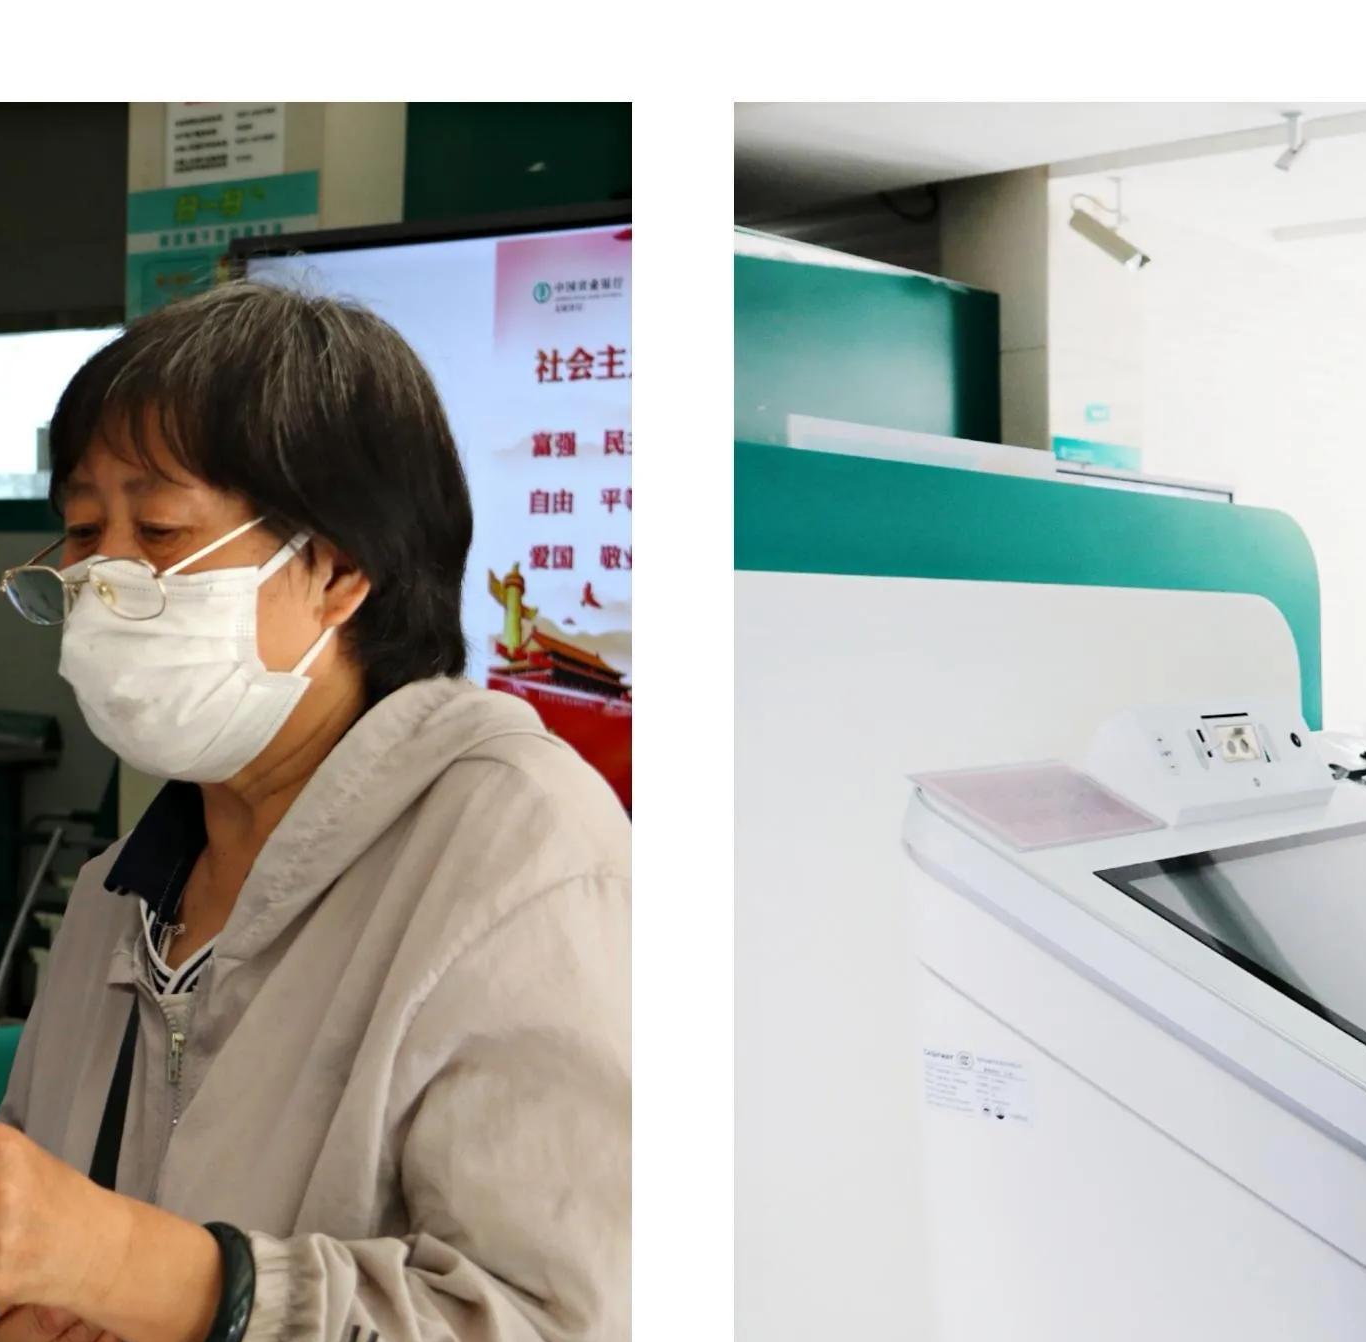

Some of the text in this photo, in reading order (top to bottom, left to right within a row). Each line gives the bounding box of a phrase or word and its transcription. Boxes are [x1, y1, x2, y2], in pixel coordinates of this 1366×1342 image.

[536, 344, 631, 383] 社会主
[532, 431, 577, 458] 富强
[529, 488, 574, 515] 自由
[529, 545, 574, 570] 爱国
